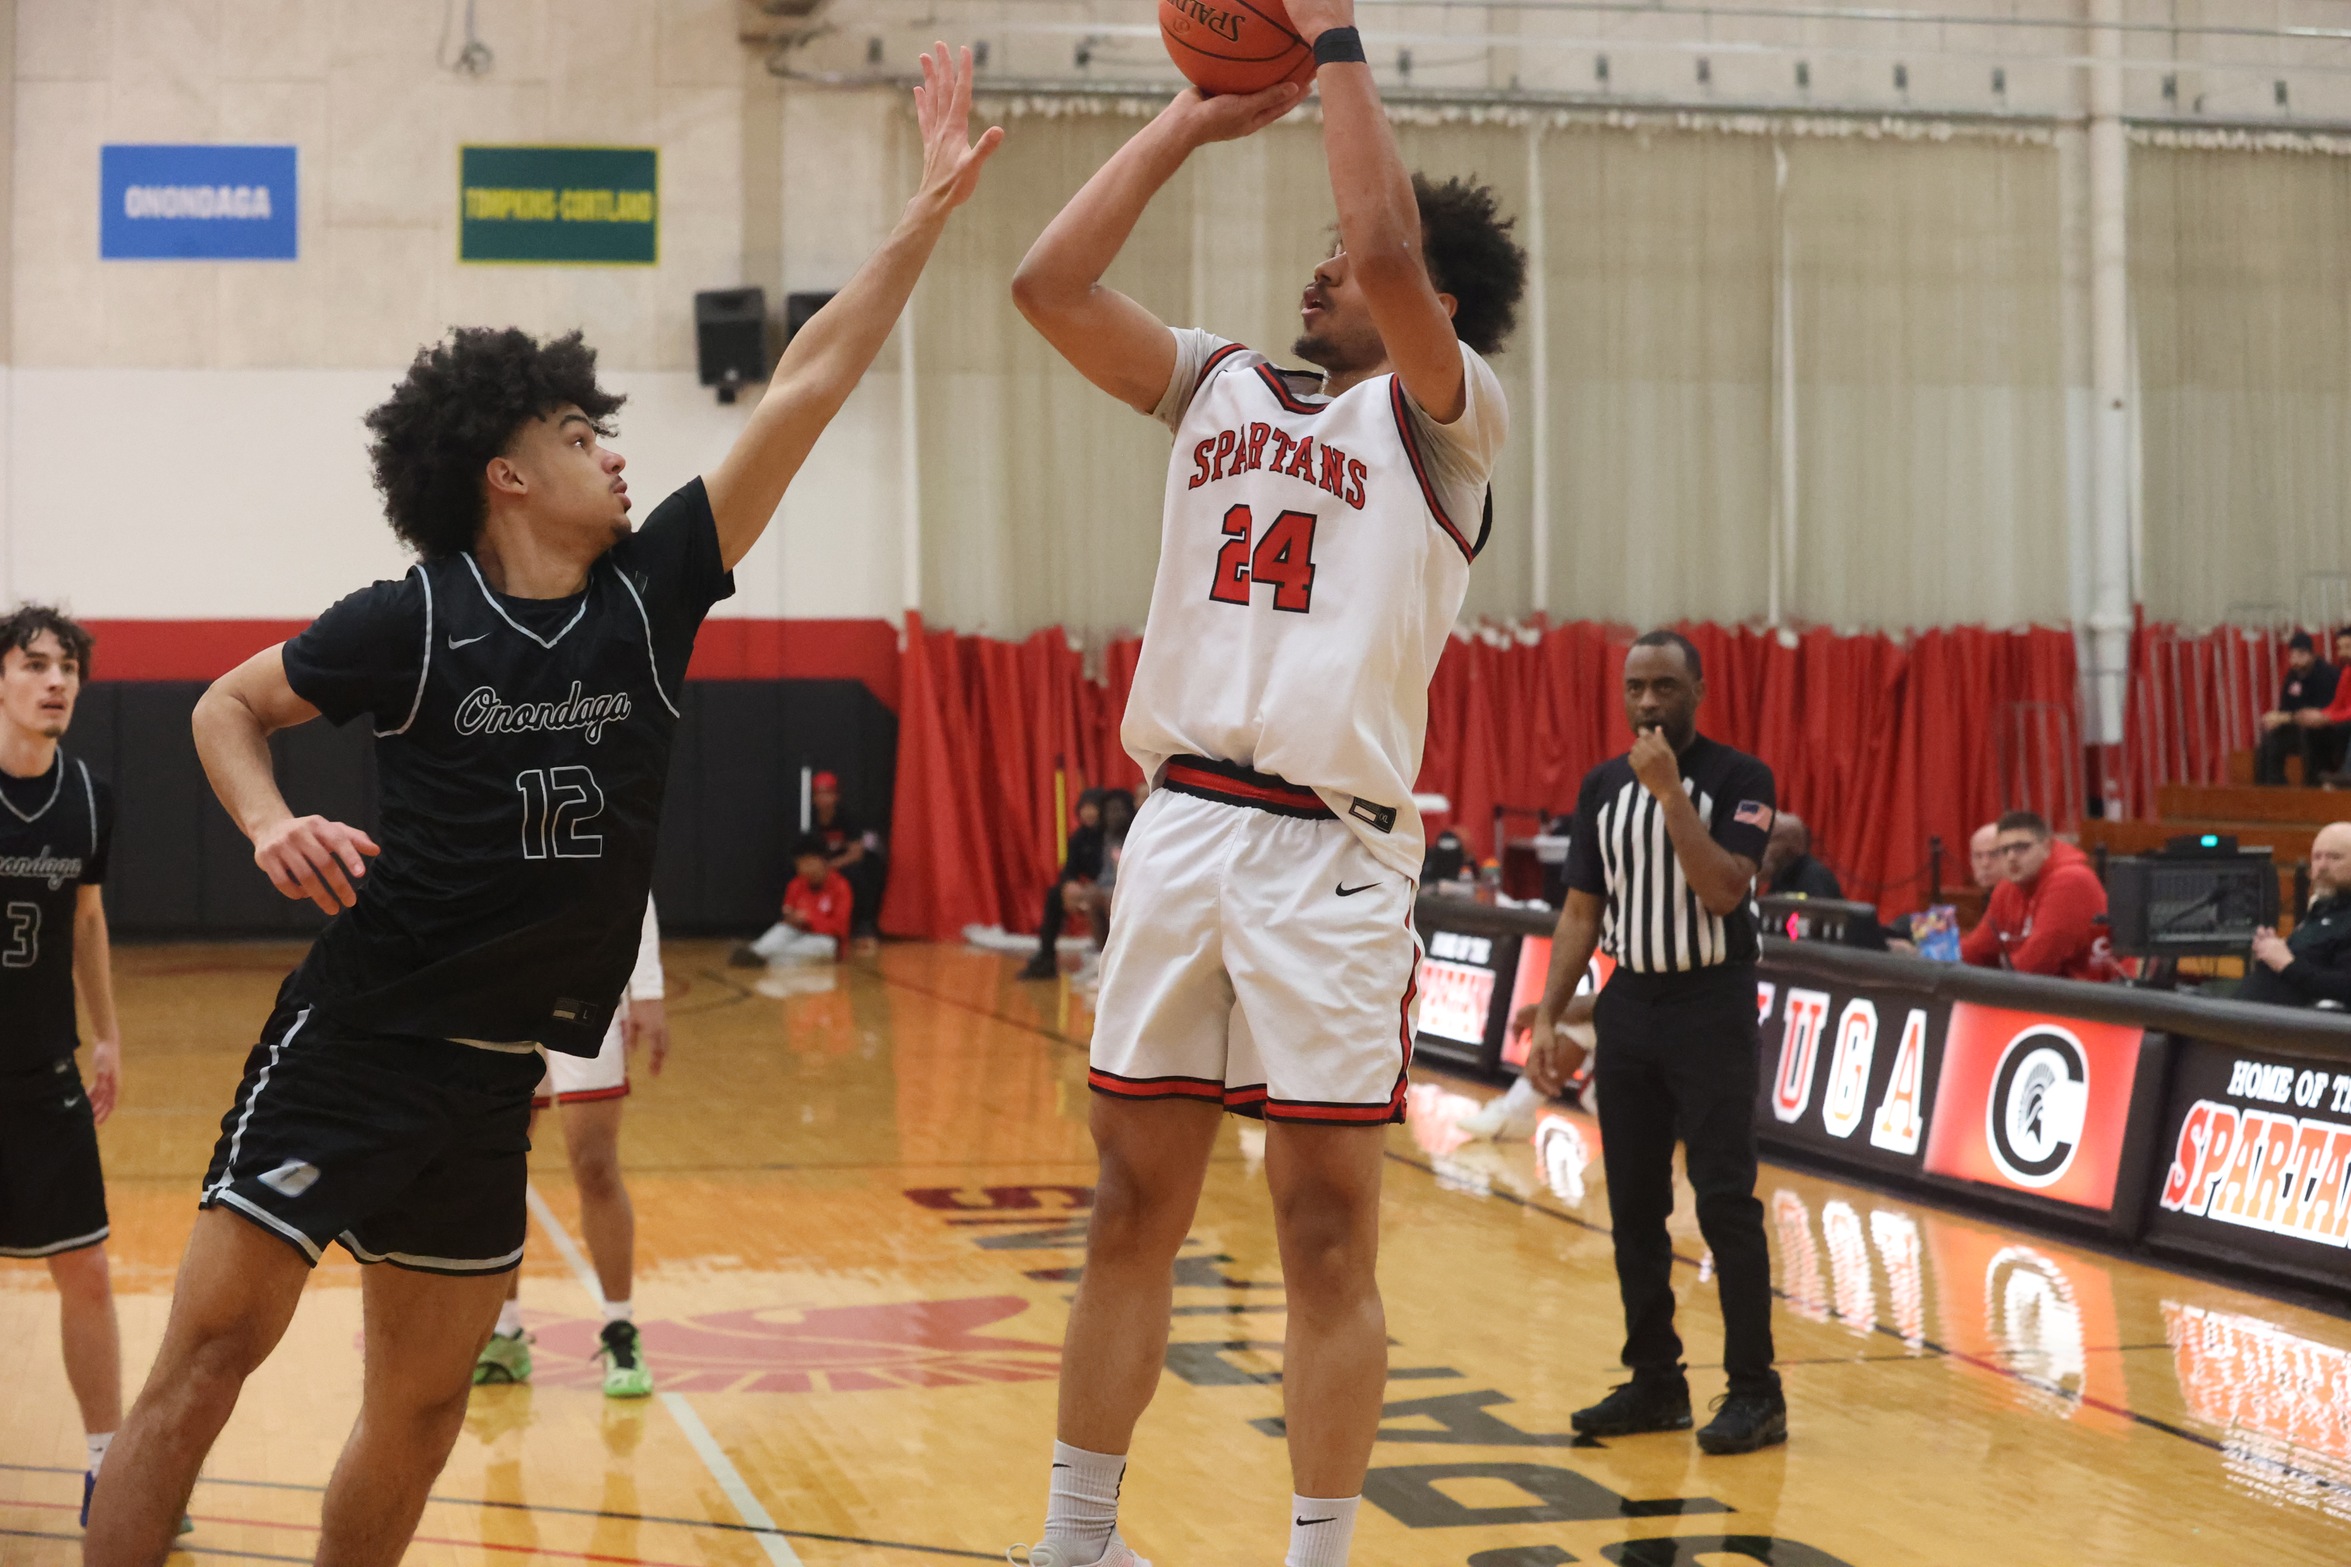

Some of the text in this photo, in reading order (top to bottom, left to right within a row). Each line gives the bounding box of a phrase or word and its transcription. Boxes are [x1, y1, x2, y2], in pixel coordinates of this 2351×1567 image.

[1167, 0, 1246, 42] SPALD
[125, 185, 271, 219] ONONDAGA
[1188, 422, 1367, 510] SPARTANS
[1208, 503, 1318, 614] 24
[454, 680, 631, 744] Onondaga
[516, 765, 604, 859] 12
[0, 845, 82, 891] ondaga
[2, 901, 42, 968] 3
[2227, 1060, 2294, 1102] HOME
[2294, 1070, 2329, 1108] OF
[2159, 1098, 2351, 1248] SPARTA
